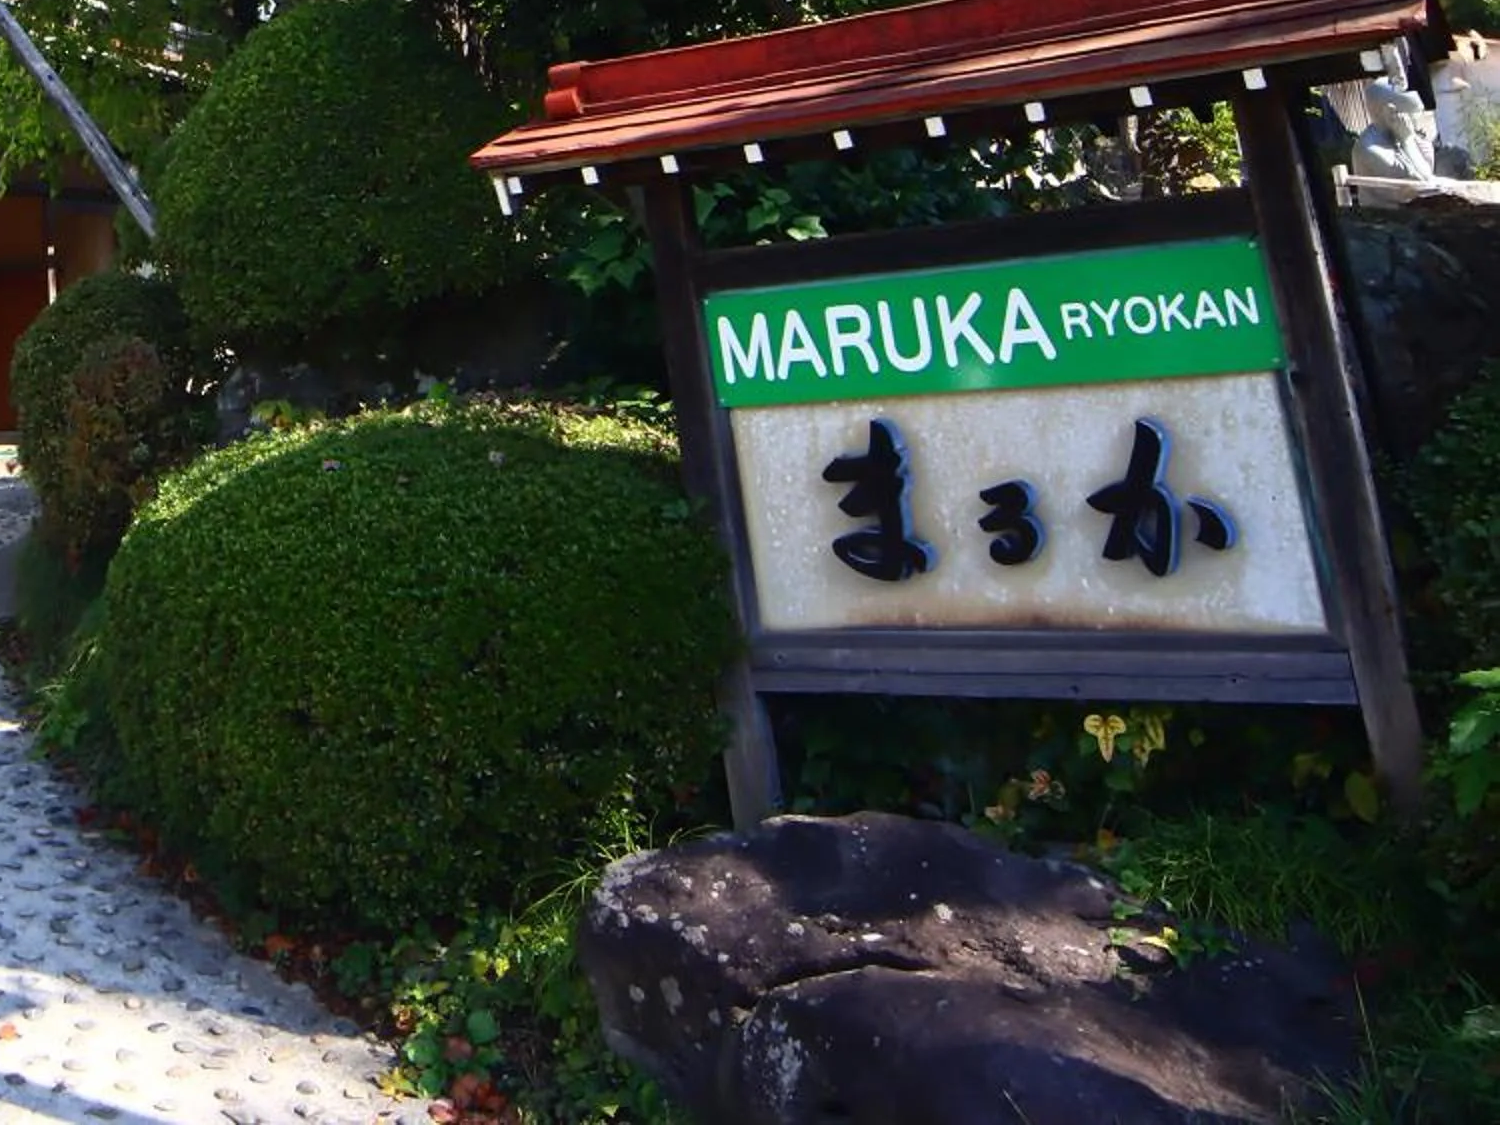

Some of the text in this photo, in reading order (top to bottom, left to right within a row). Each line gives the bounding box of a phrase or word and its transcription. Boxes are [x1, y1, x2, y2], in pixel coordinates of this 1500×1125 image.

[717, 286, 1260, 384] MARUKA RYOKAN
[822, 417, 1237, 582] まるか
